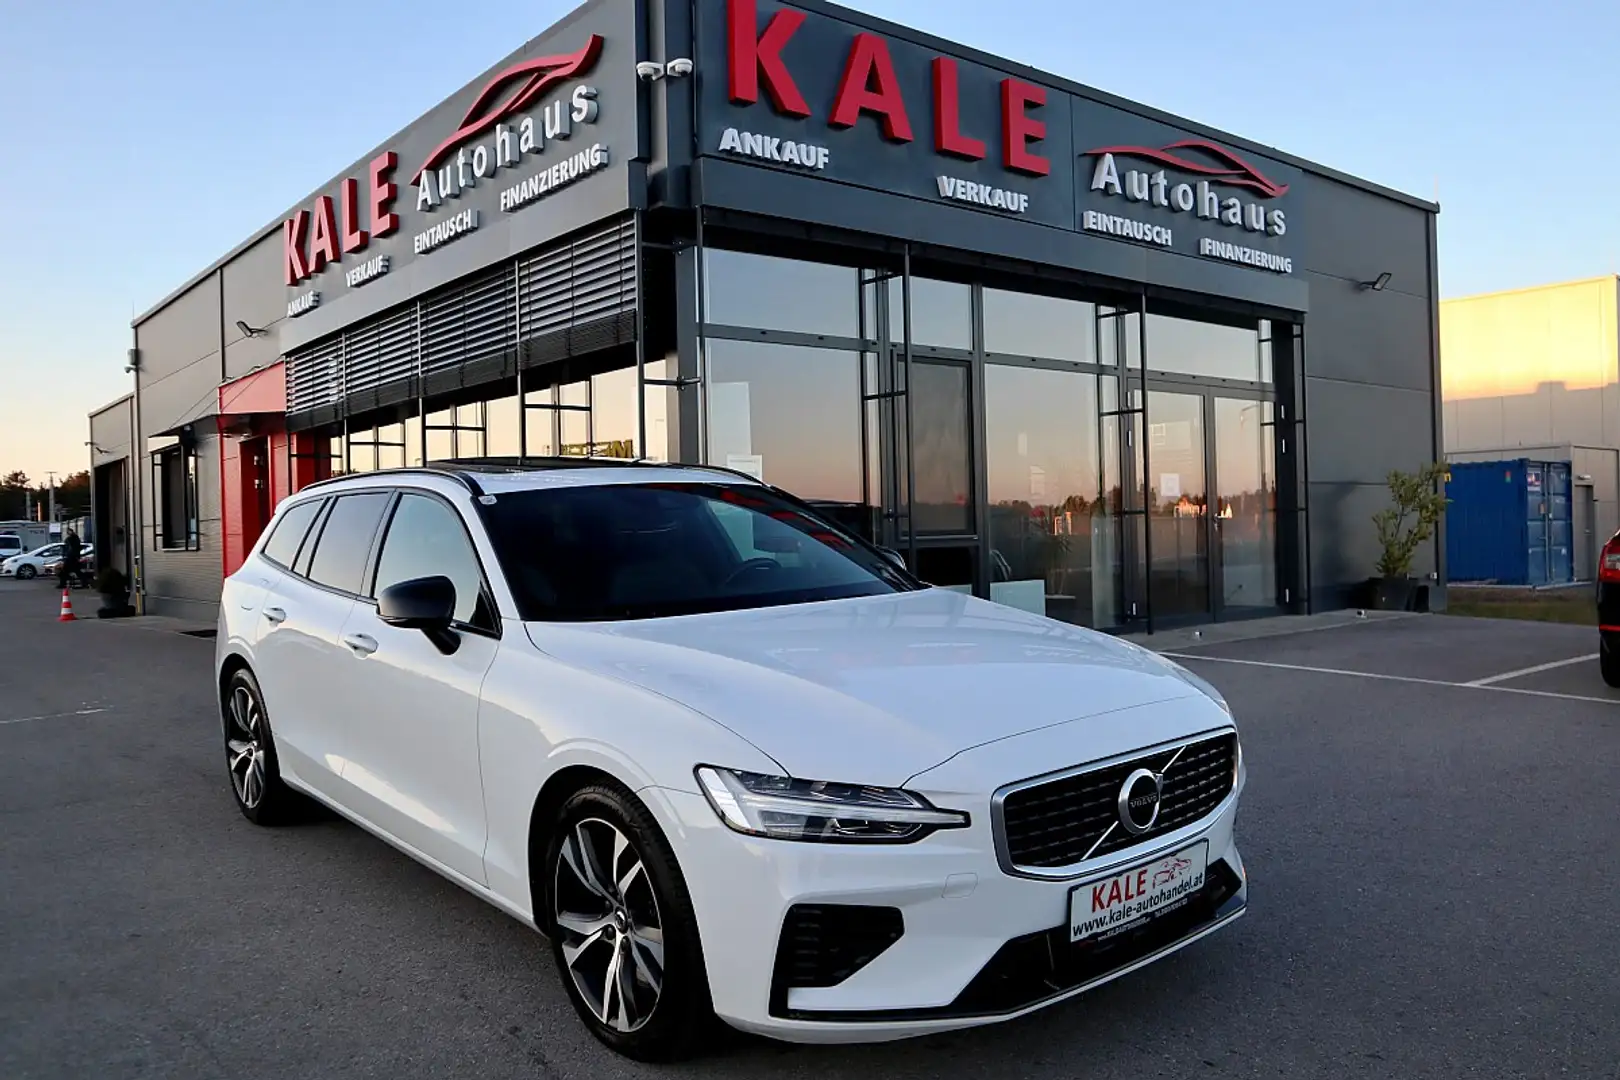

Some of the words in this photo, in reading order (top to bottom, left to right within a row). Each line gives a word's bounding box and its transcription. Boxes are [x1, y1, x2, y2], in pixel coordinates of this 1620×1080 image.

[727, 0, 1050, 177] KALE
[417, 84, 598, 211] Autohaus
[718, 127, 829, 170] ANKAUF
[500, 144, 608, 212] FINANZIERUNG
[936, 175, 1029, 213] VERKAUF
[1090, 152, 1287, 237] Autohaus
[284, 151, 398, 286] KALE
[414, 208, 479, 254] EINTAUSCH
[1082, 210, 1173, 247] EINTAUSCH
[345, 254, 389, 288] VERKAUF
[1200, 237, 1292, 273] FINANZIERUNG
[1130, 792, 1158, 808] VOLVO
[1072, 871, 1204, 938] www.kale-autohandel.at
[1091, 869, 1148, 913] KALE
